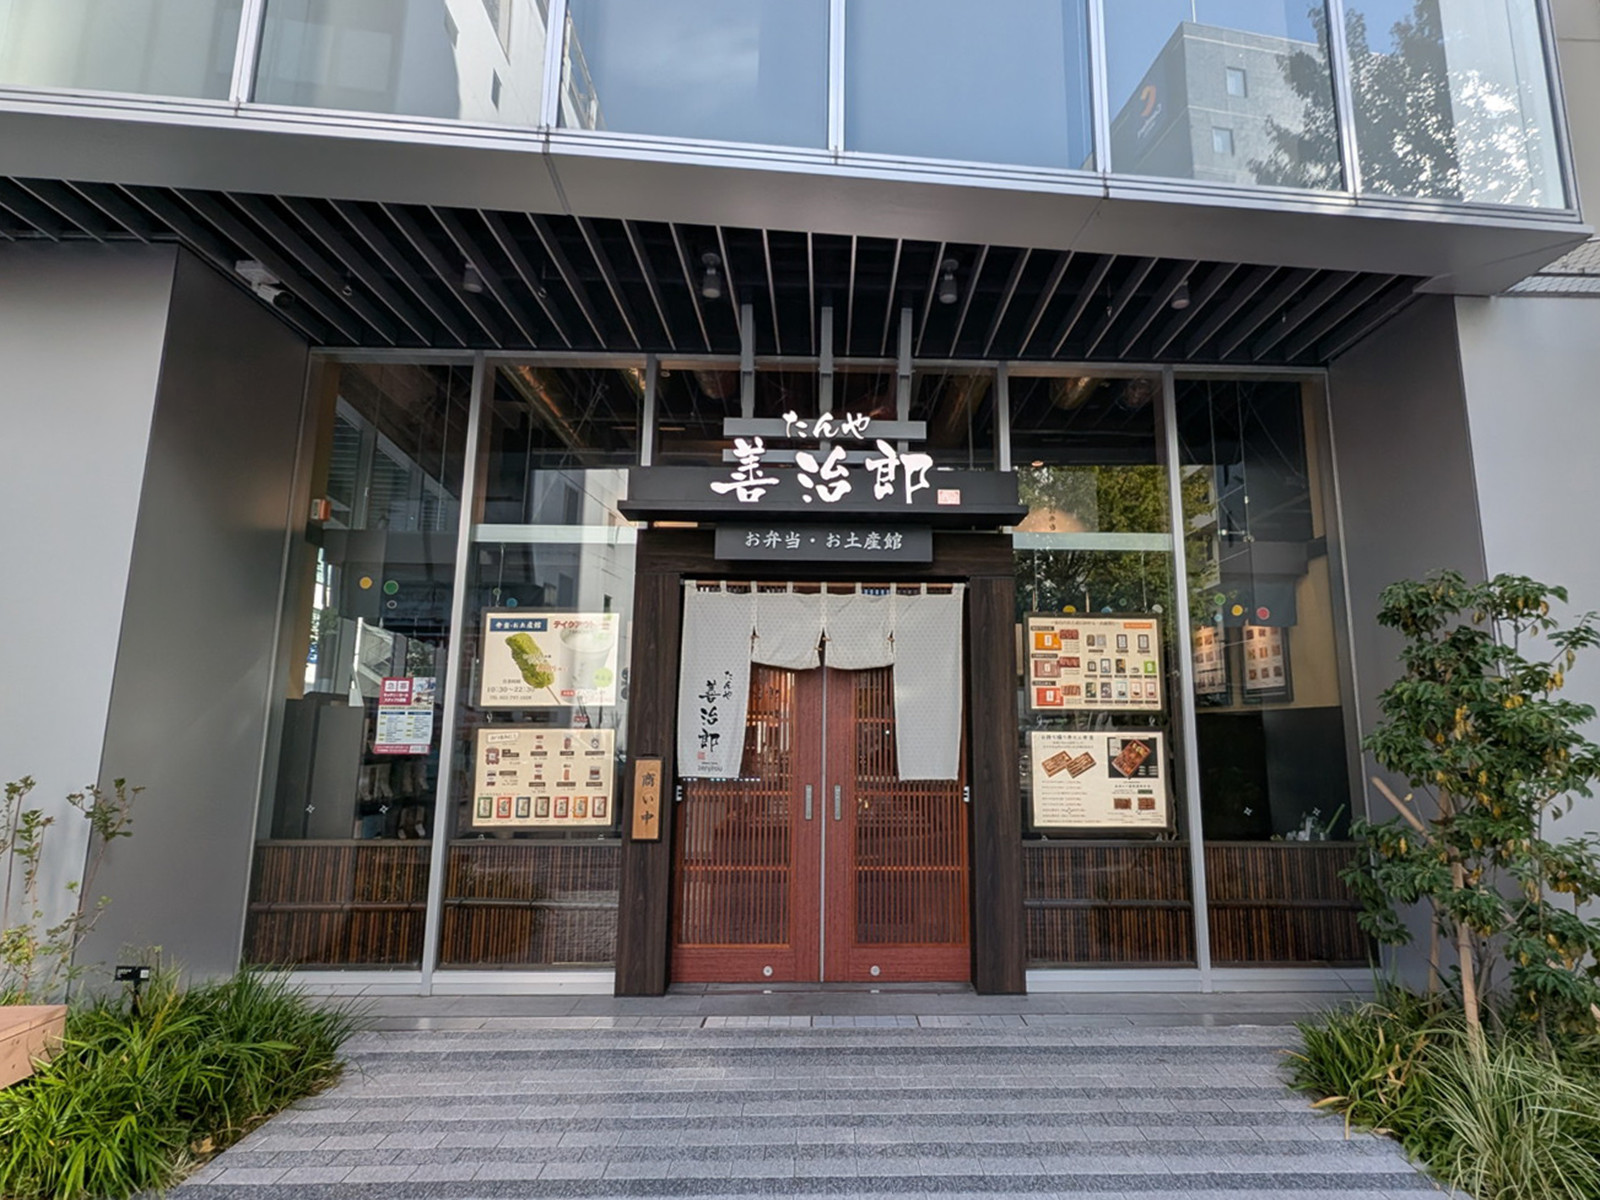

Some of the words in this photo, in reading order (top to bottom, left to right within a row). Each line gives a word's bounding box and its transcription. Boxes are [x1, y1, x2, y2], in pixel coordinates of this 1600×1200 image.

[782, 410, 871, 439] たんや
[710, 437, 934, 504] 善治郎
[745, 530, 903, 552] お弁当・お土産館
[698, 679, 722, 753] 善治郎
[641, 772, 656, 825] 商い中
